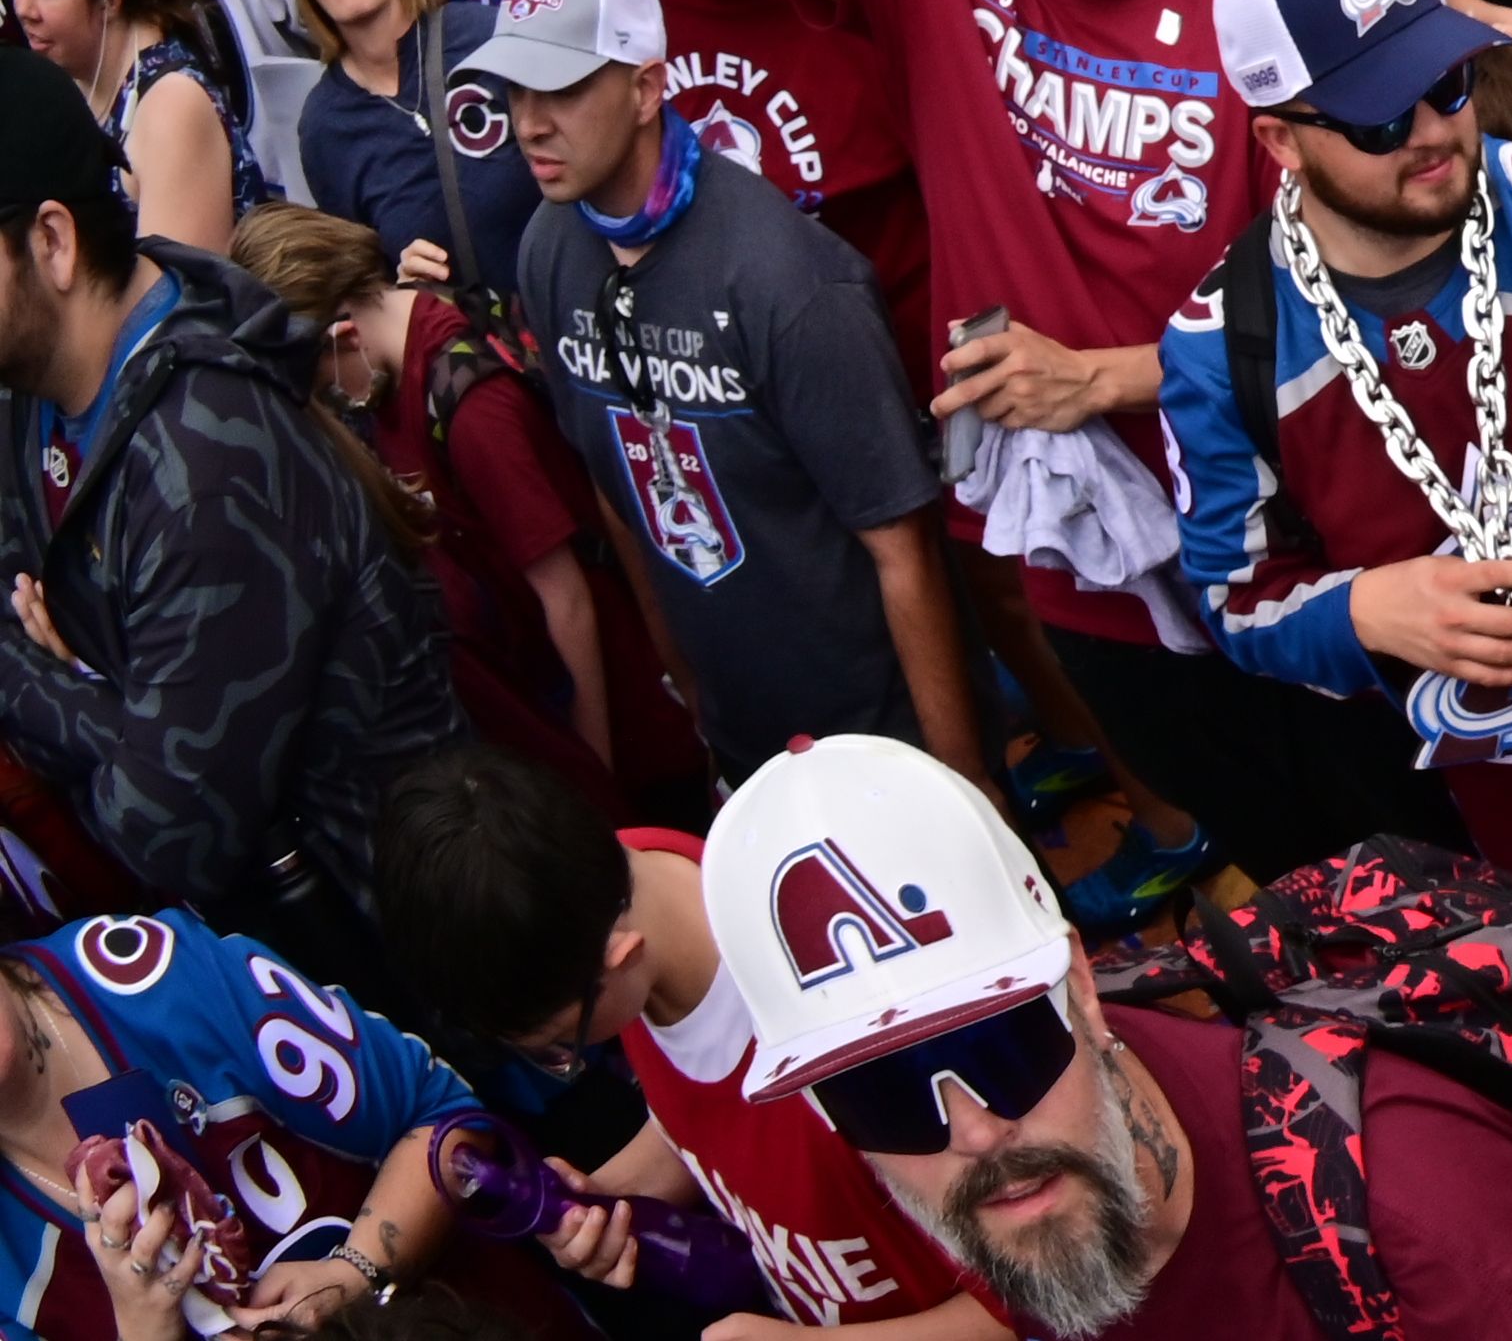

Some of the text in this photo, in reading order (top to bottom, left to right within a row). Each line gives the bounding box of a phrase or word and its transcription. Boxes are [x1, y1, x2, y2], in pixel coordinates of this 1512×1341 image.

[1149, 67, 1201, 94] CUP
[766, 89, 823, 184] CUP
[667, 325, 705, 357] CUP
[626, 439, 701, 473] 20 22
[73, 913, 175, 995] C
[249, 953, 357, 1120] 92
